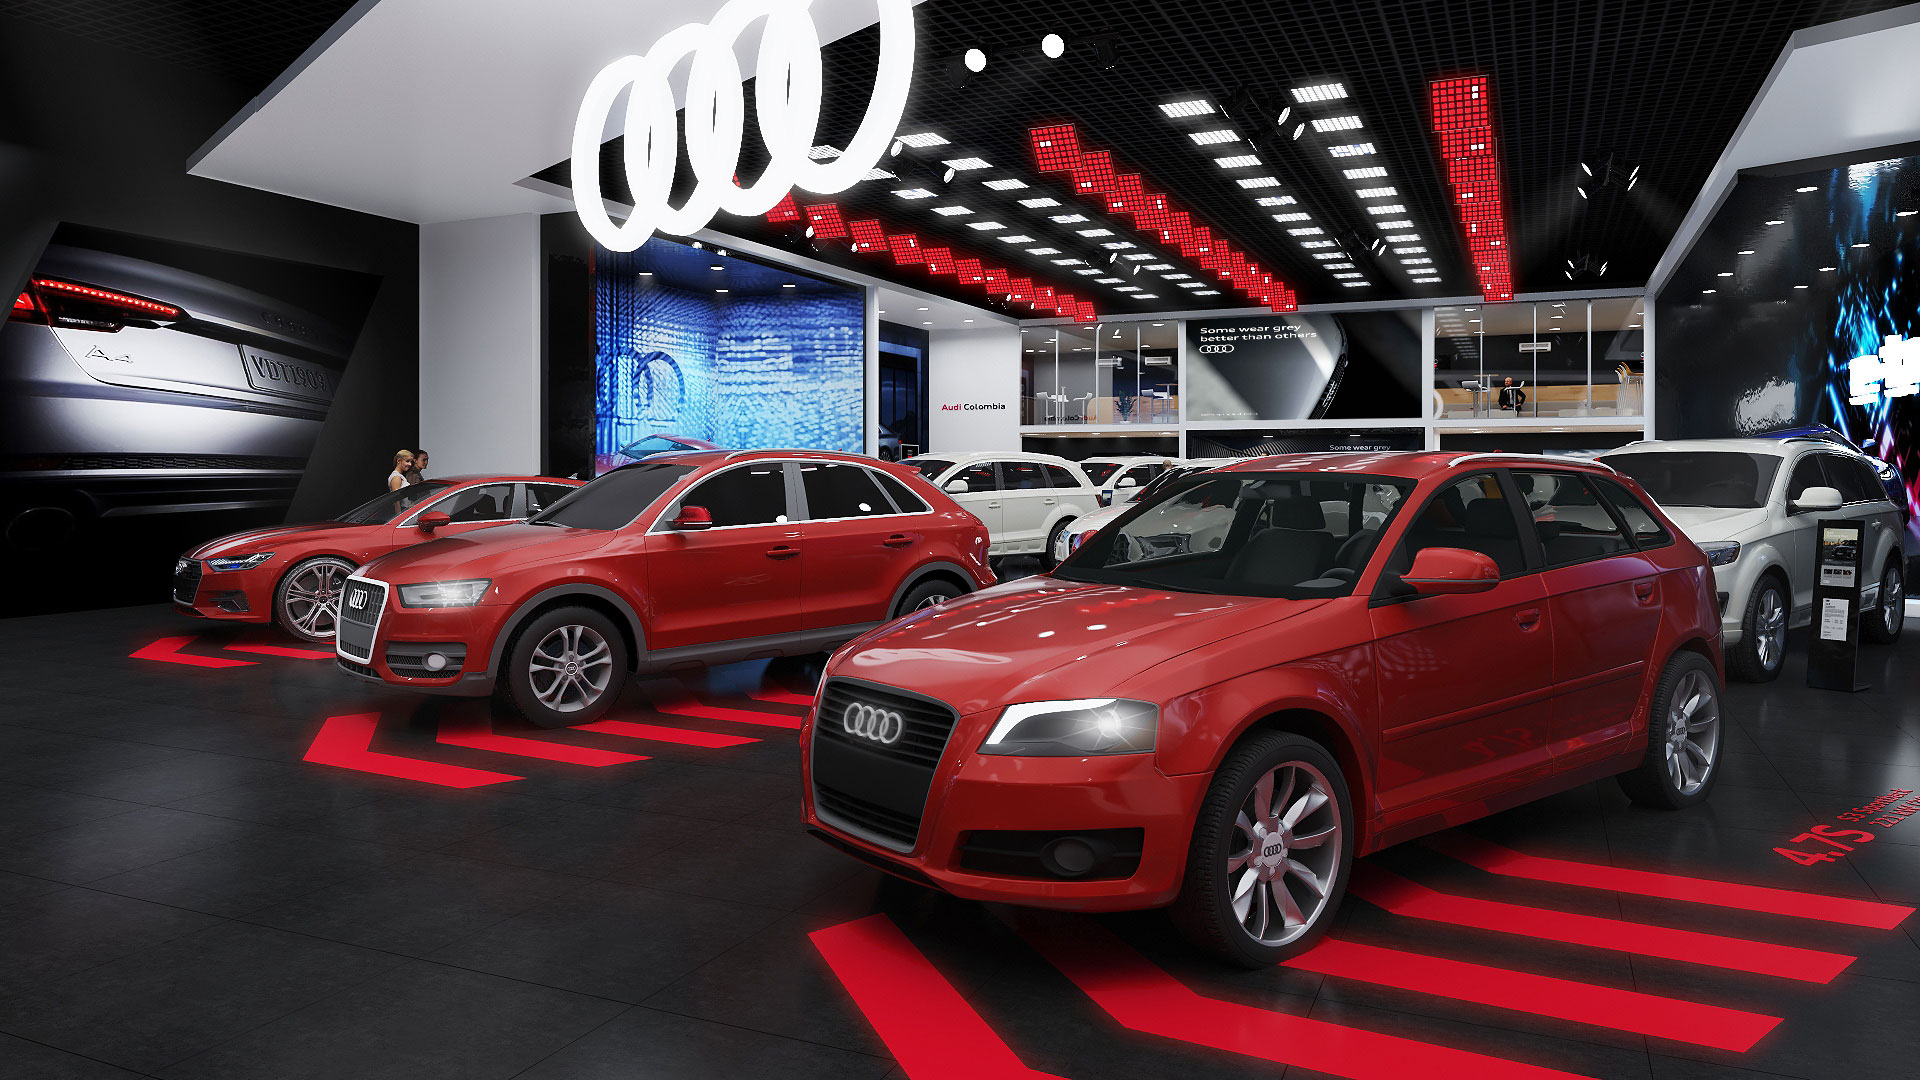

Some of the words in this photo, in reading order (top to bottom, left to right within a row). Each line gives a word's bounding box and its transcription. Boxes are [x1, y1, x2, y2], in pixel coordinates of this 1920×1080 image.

[1273, 325, 1301, 333] grey
[85, 344, 134, 364] A4
[941, 403, 962, 411] Audi
[963, 403, 1006, 411] Colombia
